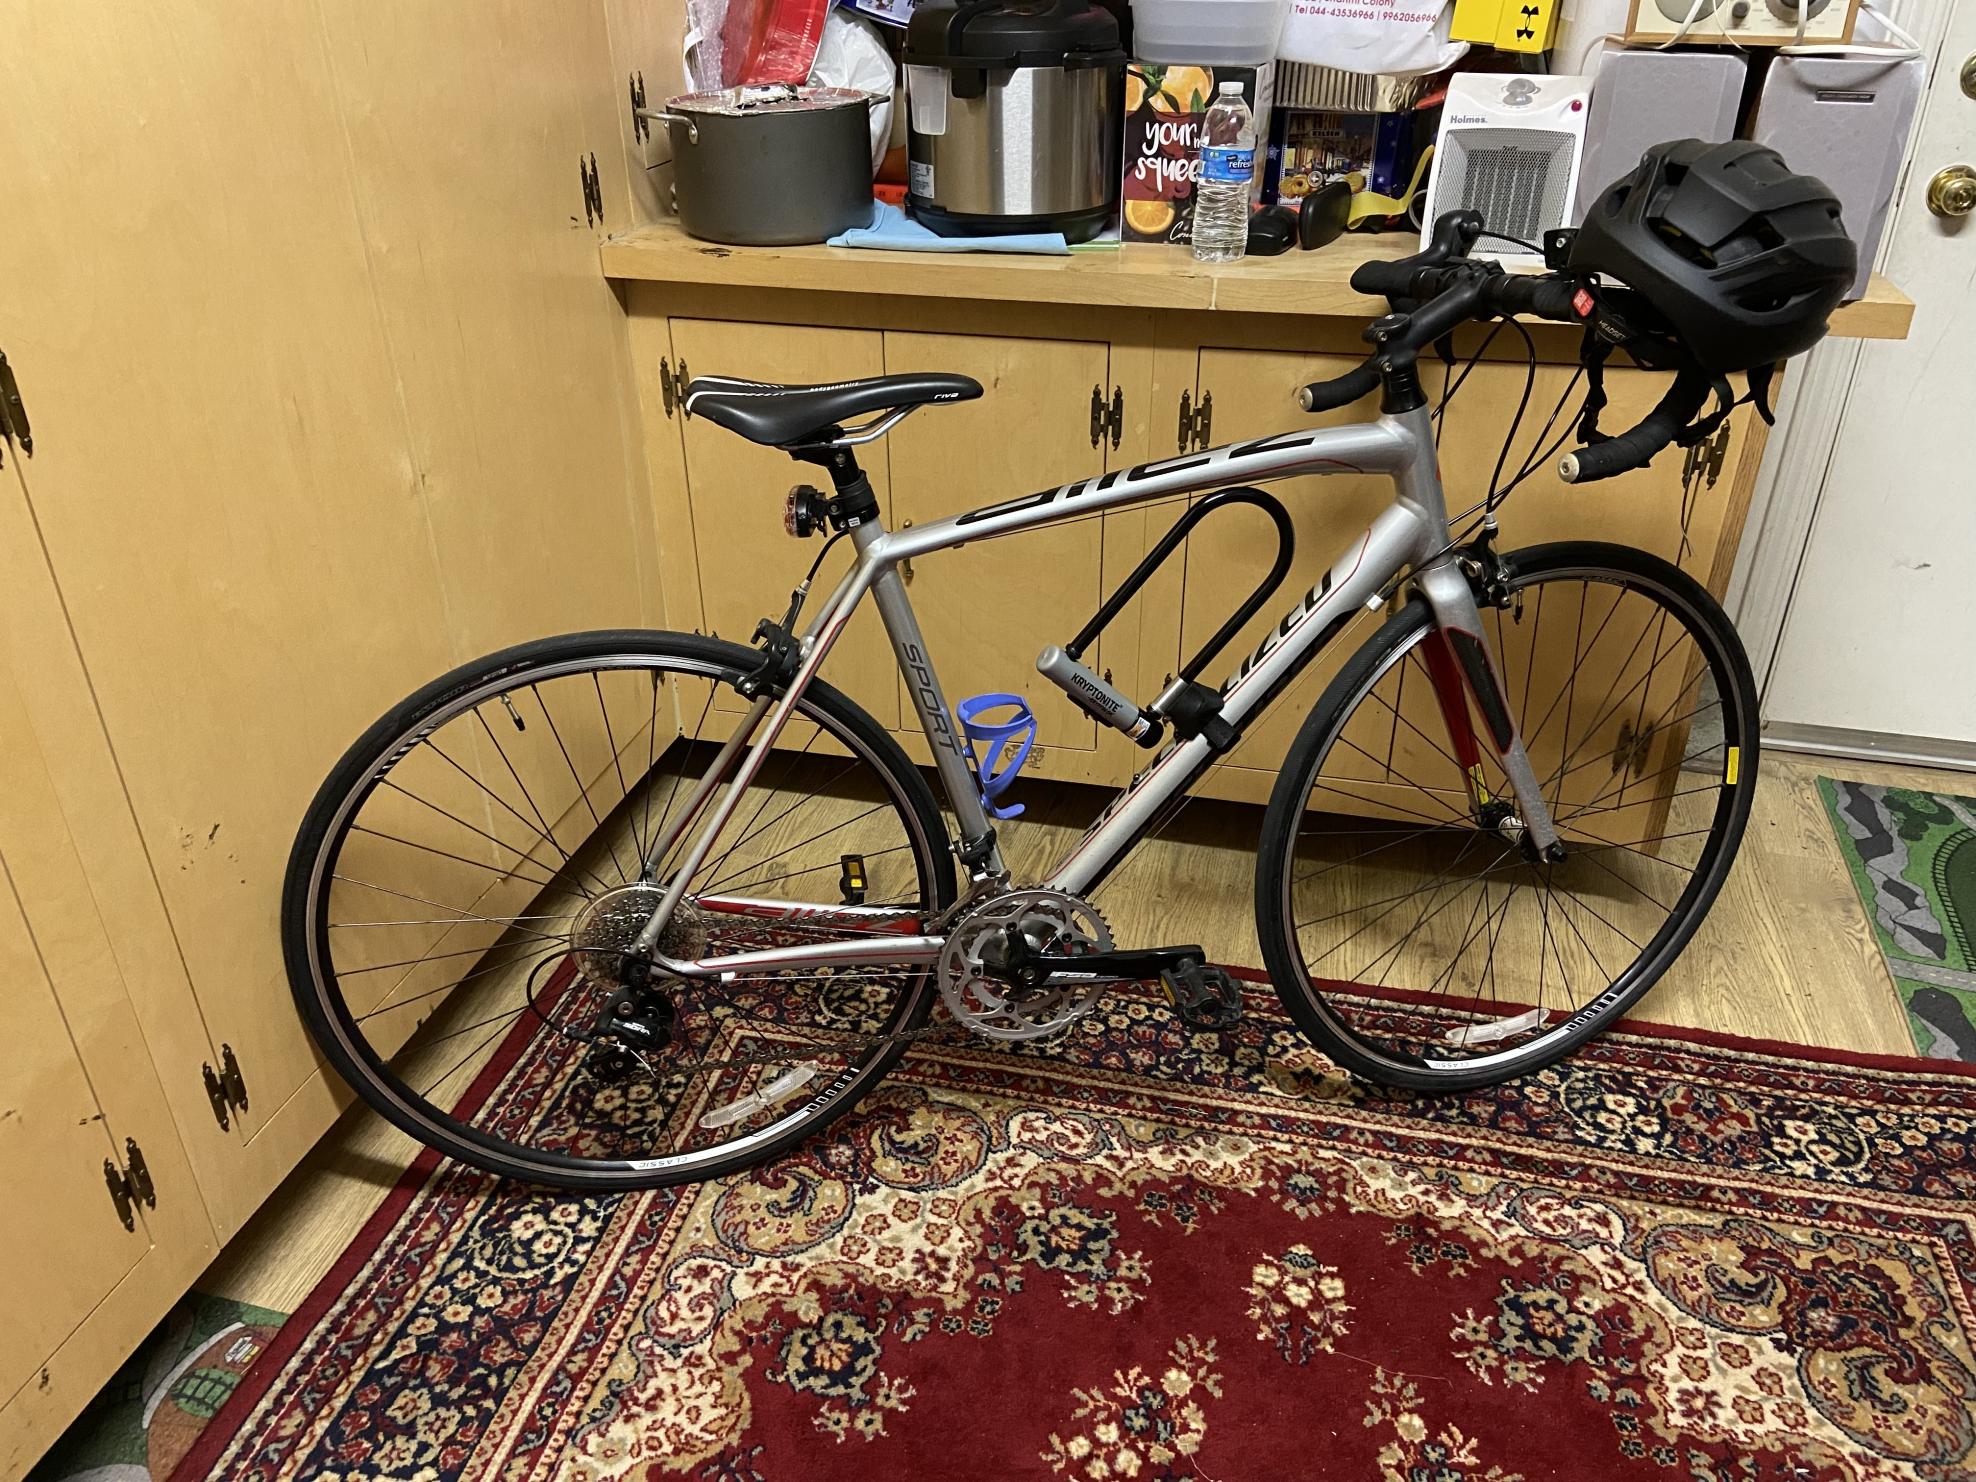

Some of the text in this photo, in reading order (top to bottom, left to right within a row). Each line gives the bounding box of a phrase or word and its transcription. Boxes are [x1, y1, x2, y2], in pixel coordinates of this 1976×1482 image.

[1295, 5, 1437, 22] Tel 044-43536966 9962056966
[1450, 115, 1486, 124] Holmes
[1142, 121, 1197, 156] your
[901, 642, 959, 756] SPORT
[1070, 672, 1121, 713] KRYPTONITE
